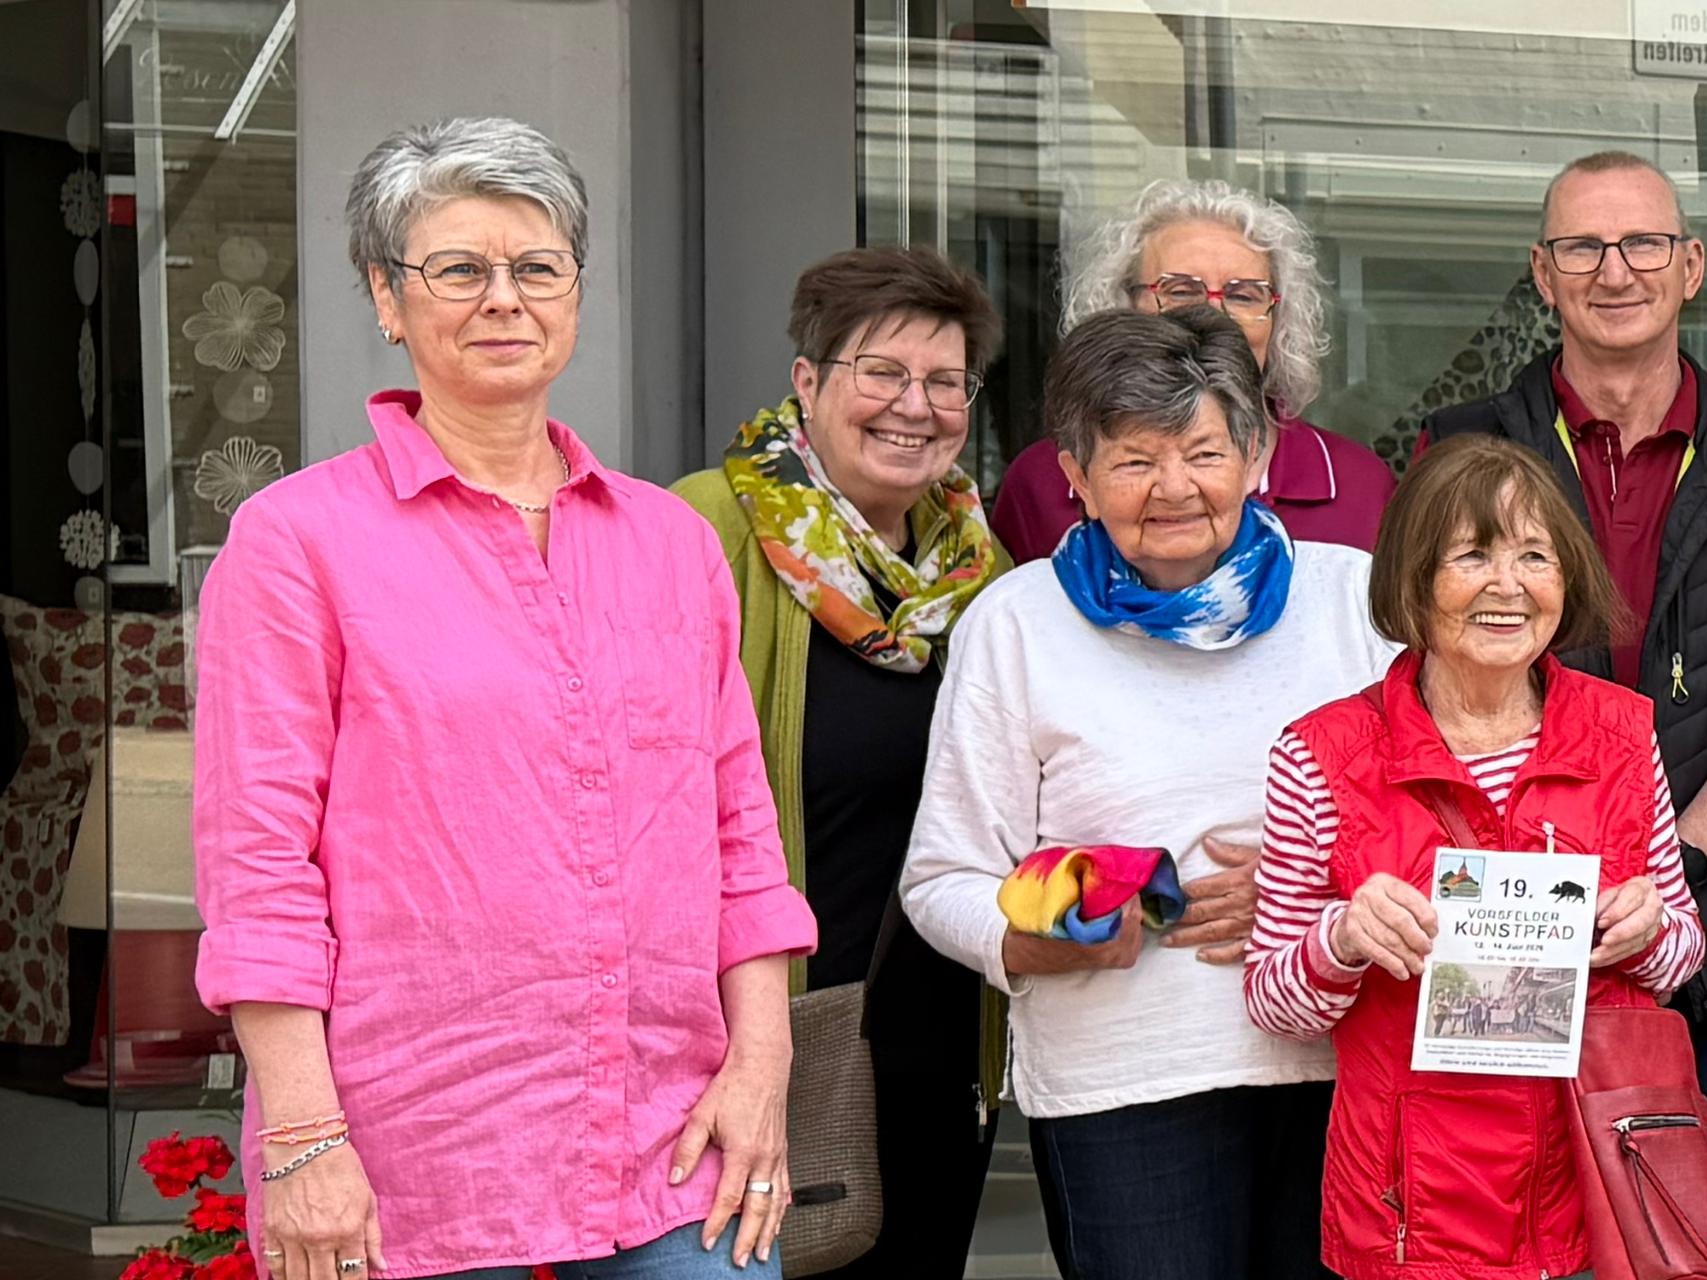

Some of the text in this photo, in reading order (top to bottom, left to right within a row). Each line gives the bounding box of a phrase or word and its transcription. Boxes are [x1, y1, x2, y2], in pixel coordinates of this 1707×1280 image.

[1499, 878, 1534, 899] 19.
[1468, 908, 1560, 922] VORSFELDER
[1454, 920, 1575, 941] KUNSTPFAD
